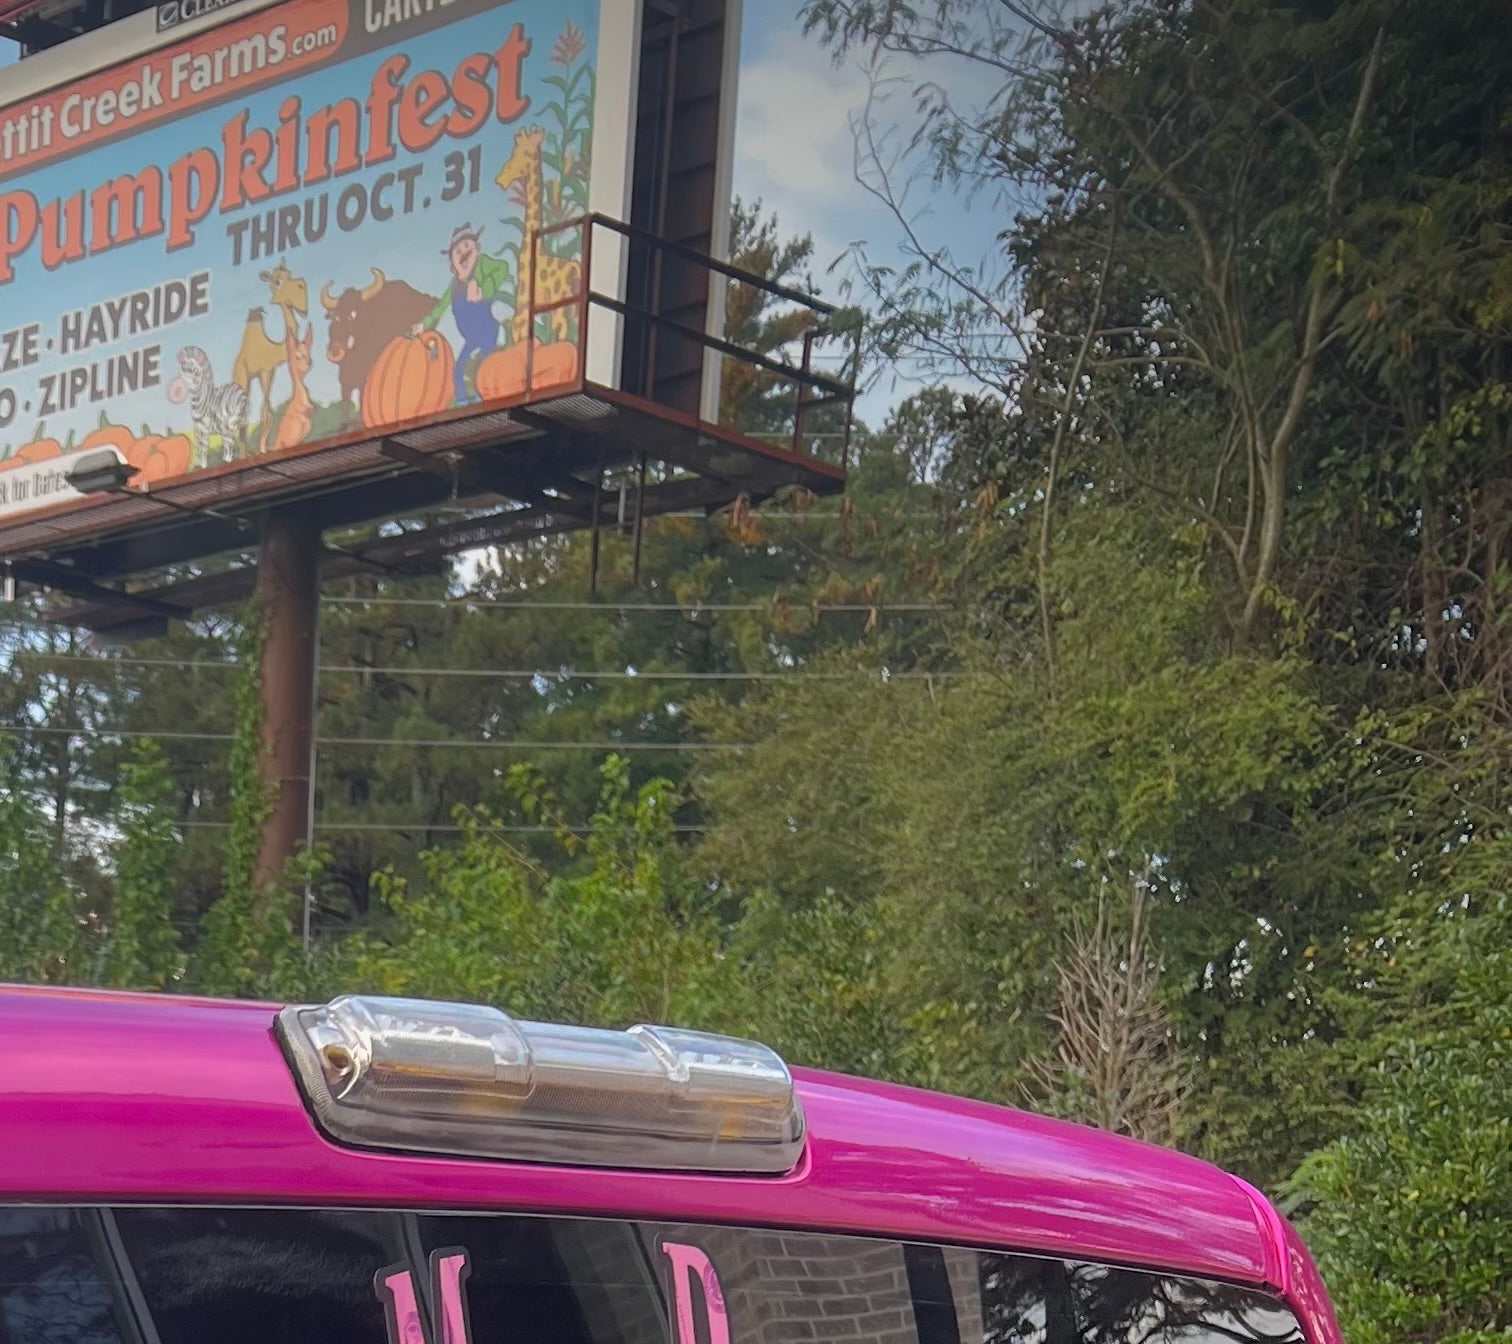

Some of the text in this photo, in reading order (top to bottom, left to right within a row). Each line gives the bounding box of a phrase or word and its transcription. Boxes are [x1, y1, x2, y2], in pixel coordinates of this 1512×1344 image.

[226, 144, 482, 266] THRU OCT. 31
[60, 272, 209, 354] HAYRIDE
[38, 344, 161, 418] ZIPLINE
